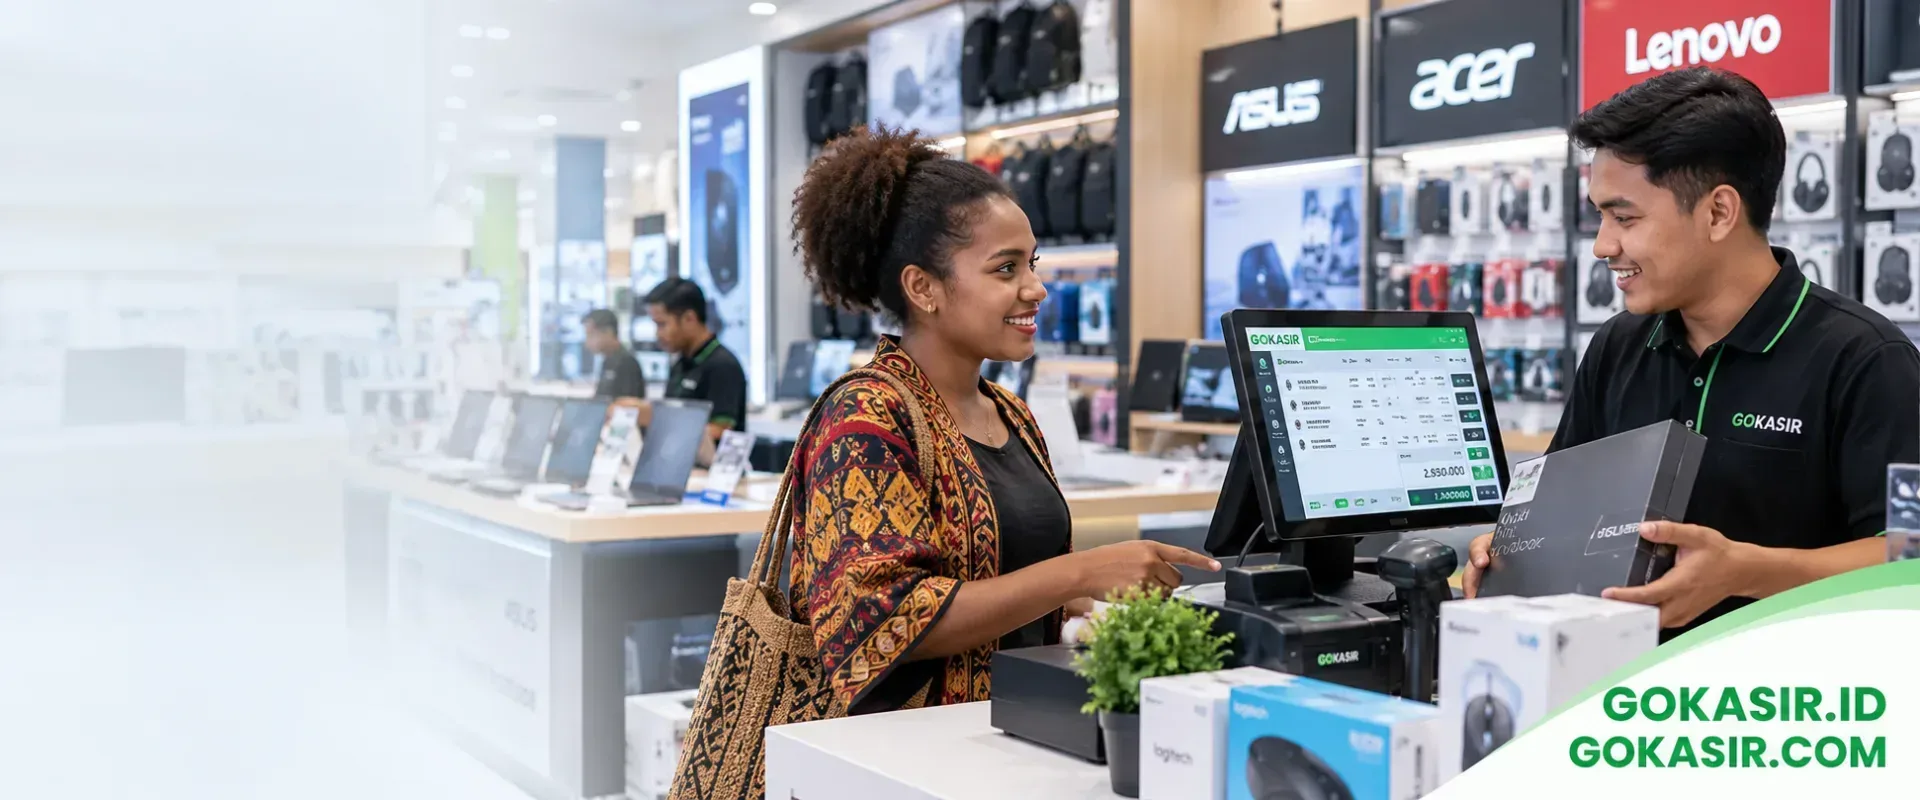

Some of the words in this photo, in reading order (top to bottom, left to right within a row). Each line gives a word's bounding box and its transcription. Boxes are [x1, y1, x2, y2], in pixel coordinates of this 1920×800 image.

[1625, 13, 1782, 75] Lenovo
[1409, 42, 1536, 111] acer
[1223, 78, 1323, 135] ASUS
[1250, 334, 1300, 345] GOKASIR
[1731, 412, 1803, 434] GOKASIR
[1317, 650, 1359, 666] GOKASIR
